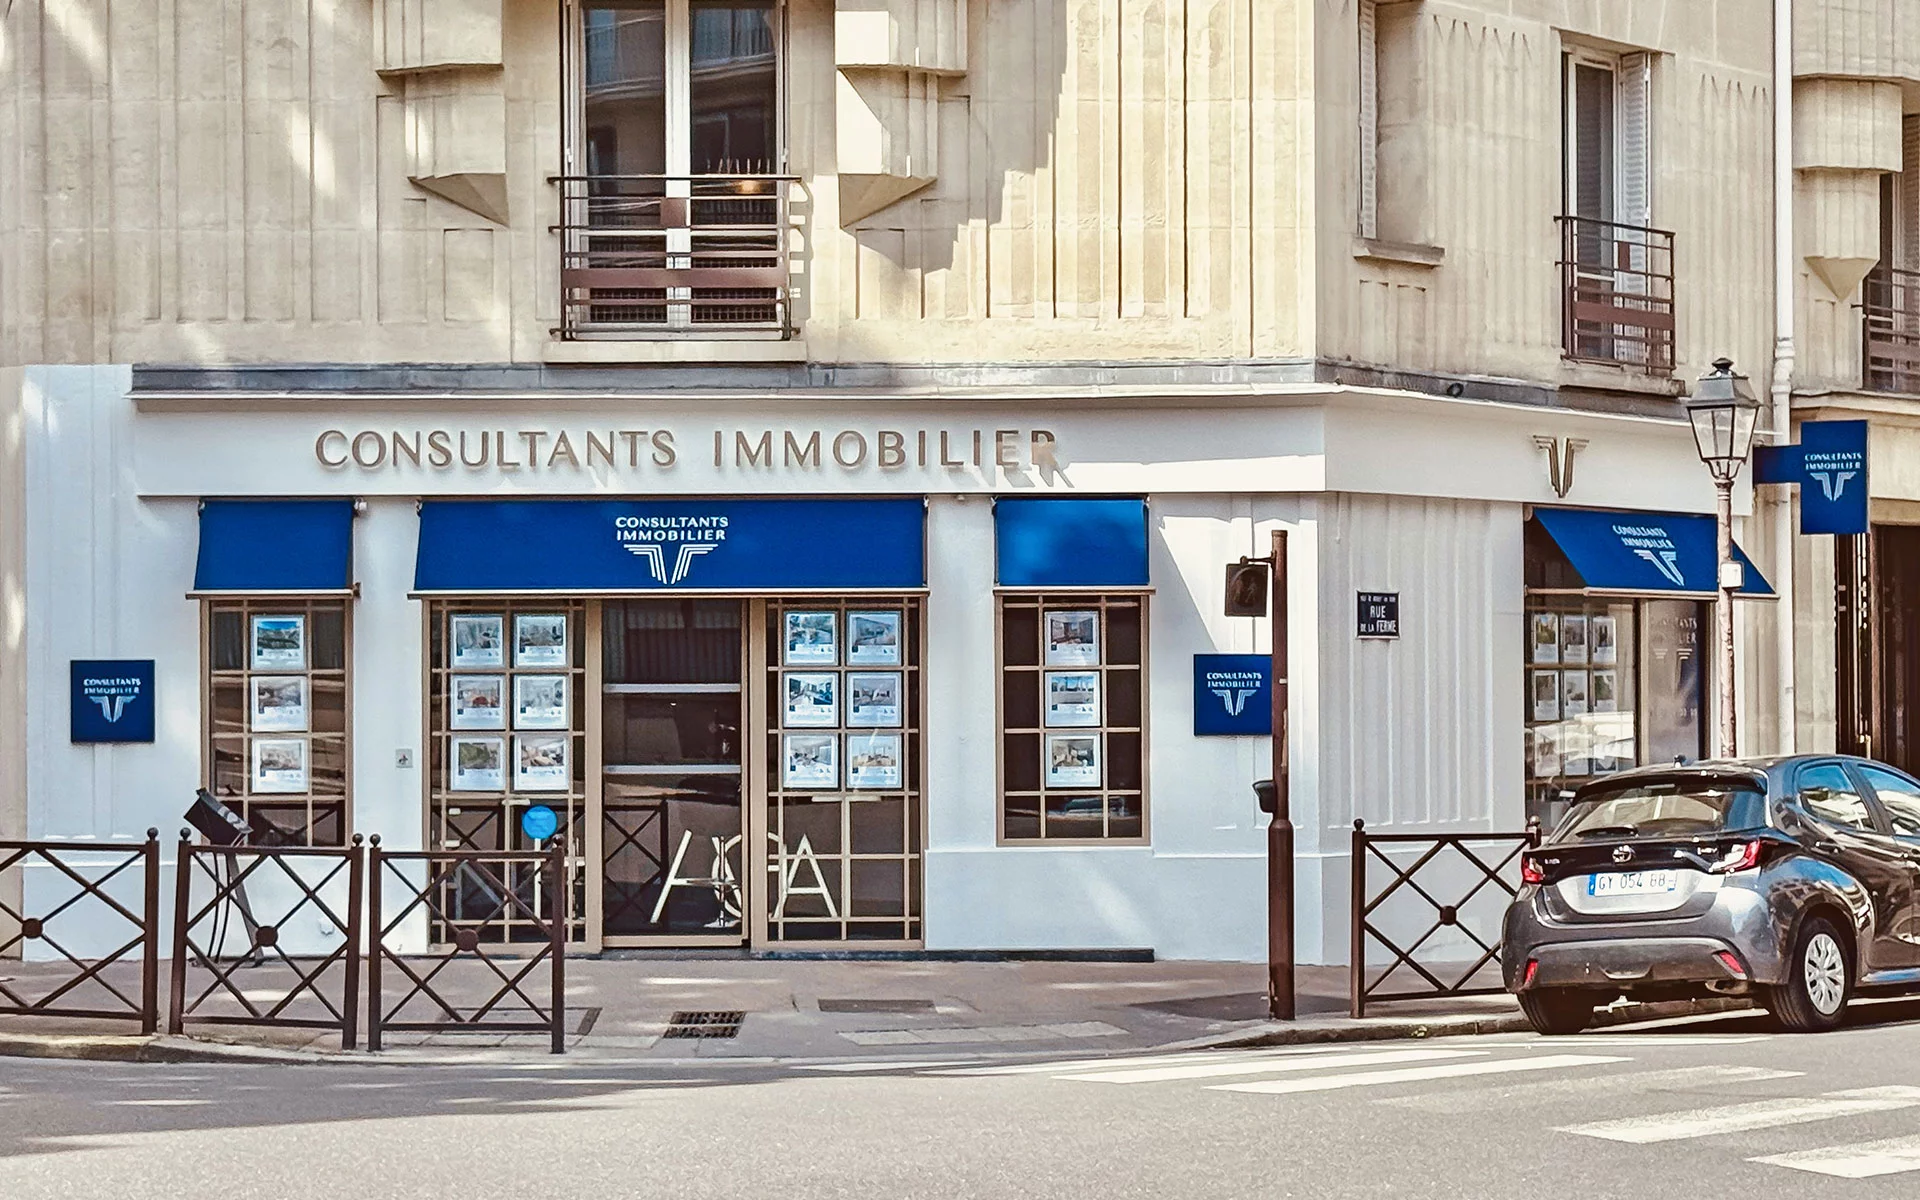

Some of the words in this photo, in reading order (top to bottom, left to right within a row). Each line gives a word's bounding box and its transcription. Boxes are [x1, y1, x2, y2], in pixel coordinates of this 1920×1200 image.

[315, 429, 678, 468] CONSULTANTS
[714, 429, 1058, 468] IMMOBILIER
[615, 516, 729, 529] CONSULTANTS
[616, 529, 726, 541] IMMOBILIER
[1370, 605, 1387, 619] RUE
[1367, 623, 1375, 633] LA
[1206, 672, 1263, 680] CONSULTANTS
